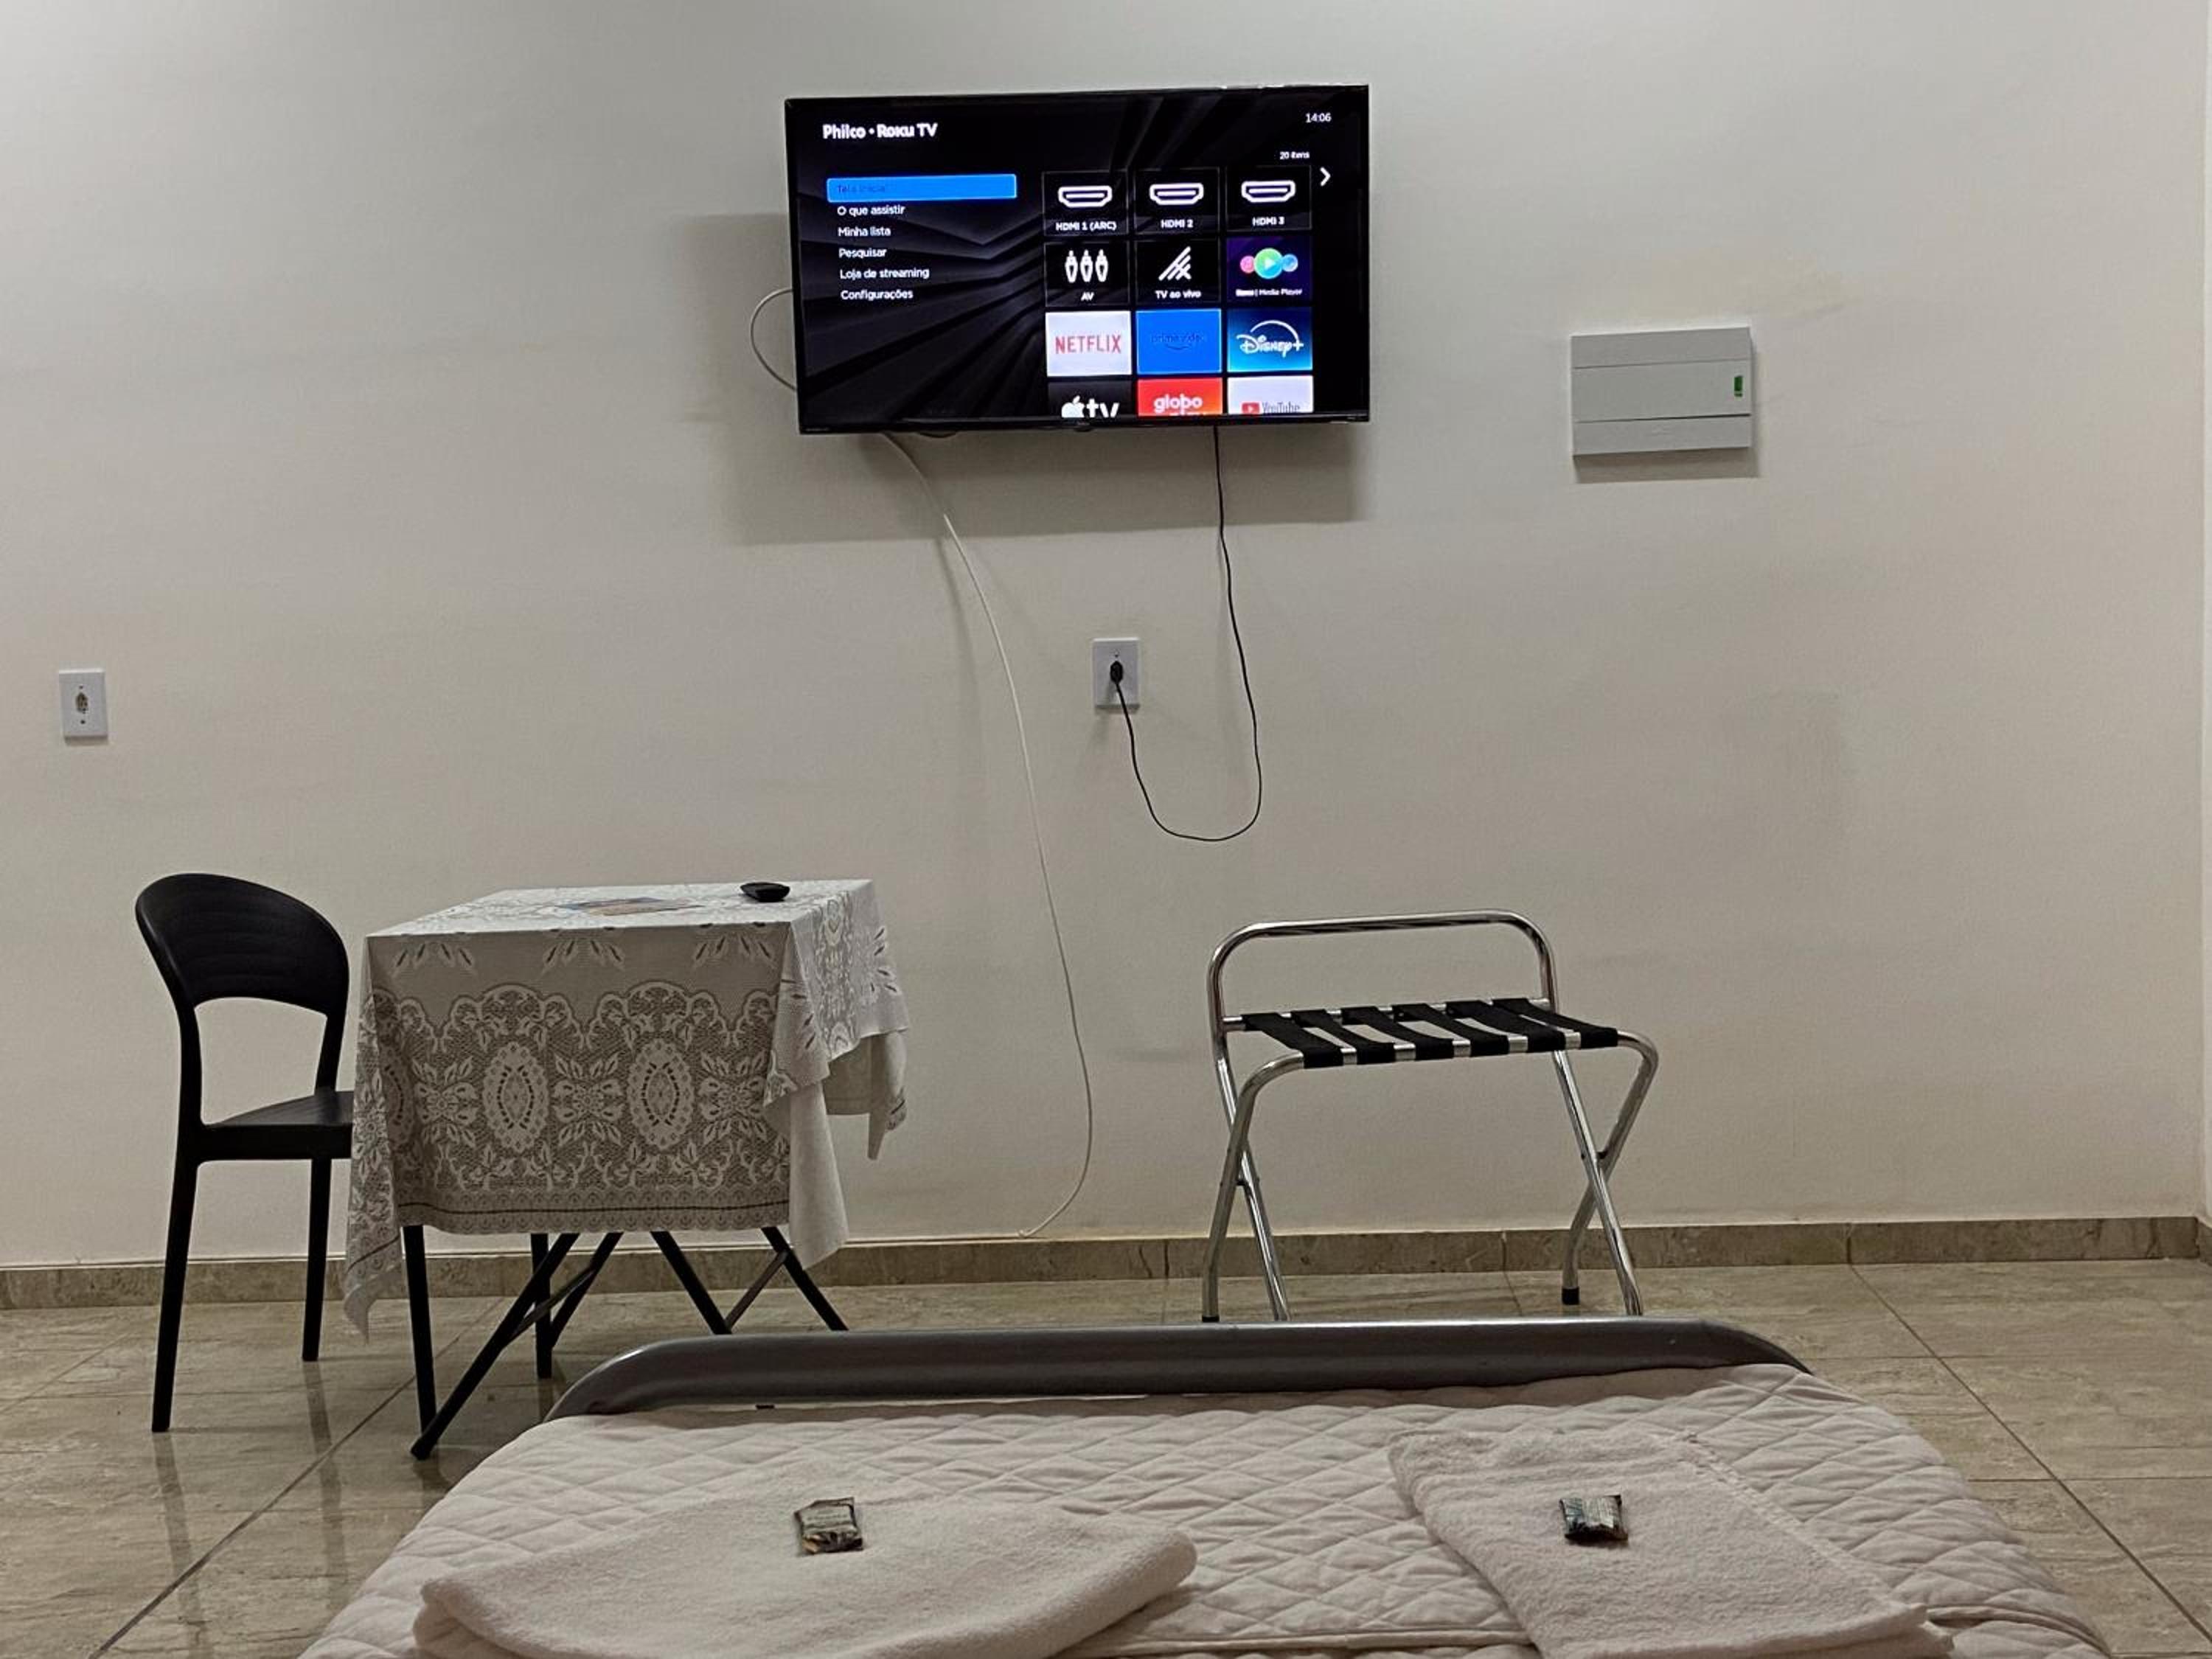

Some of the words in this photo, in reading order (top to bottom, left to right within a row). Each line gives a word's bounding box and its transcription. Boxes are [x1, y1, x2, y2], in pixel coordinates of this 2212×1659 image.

[1306, 112, 1332, 123] 14:06
[822, 123, 867, 139] Philco
[876, 123, 915, 139] Roku
[916, 122, 939, 138] TV
[1279, 151, 1290, 160] 20
[837, 205, 847, 216] O
[849, 206, 869, 218] que
[870, 204, 906, 215] assistir
[1055, 221, 1080, 232] HDMI
[1082, 221, 1088, 231] 1
[1089, 220, 1117, 232] (ARC)
[1160, 218, 1186, 229] HDMI
[1186, 218, 1194, 229] 2
[1252, 216, 1278, 226] HDMI
[1278, 216, 1285, 225] 3
[838, 226, 869, 237] Minha
[867, 226, 891, 237] lista
[838, 247, 887, 259] Pesquisar
[839, 268, 862, 281] Loja
[863, 268, 877, 279] de
[878, 267, 930, 279] streaming
[840, 288, 914, 302] Configurações
[1080, 291, 1095, 302] AV
[1155, 290, 1169, 299] TV
[1169, 291, 1182, 299] ao
[1182, 289, 1202, 299] vivo
[1055, 334, 1121, 355] NETFLIX
[1087, 397, 1119, 418] tv
[1154, 394, 1203, 413] globo
